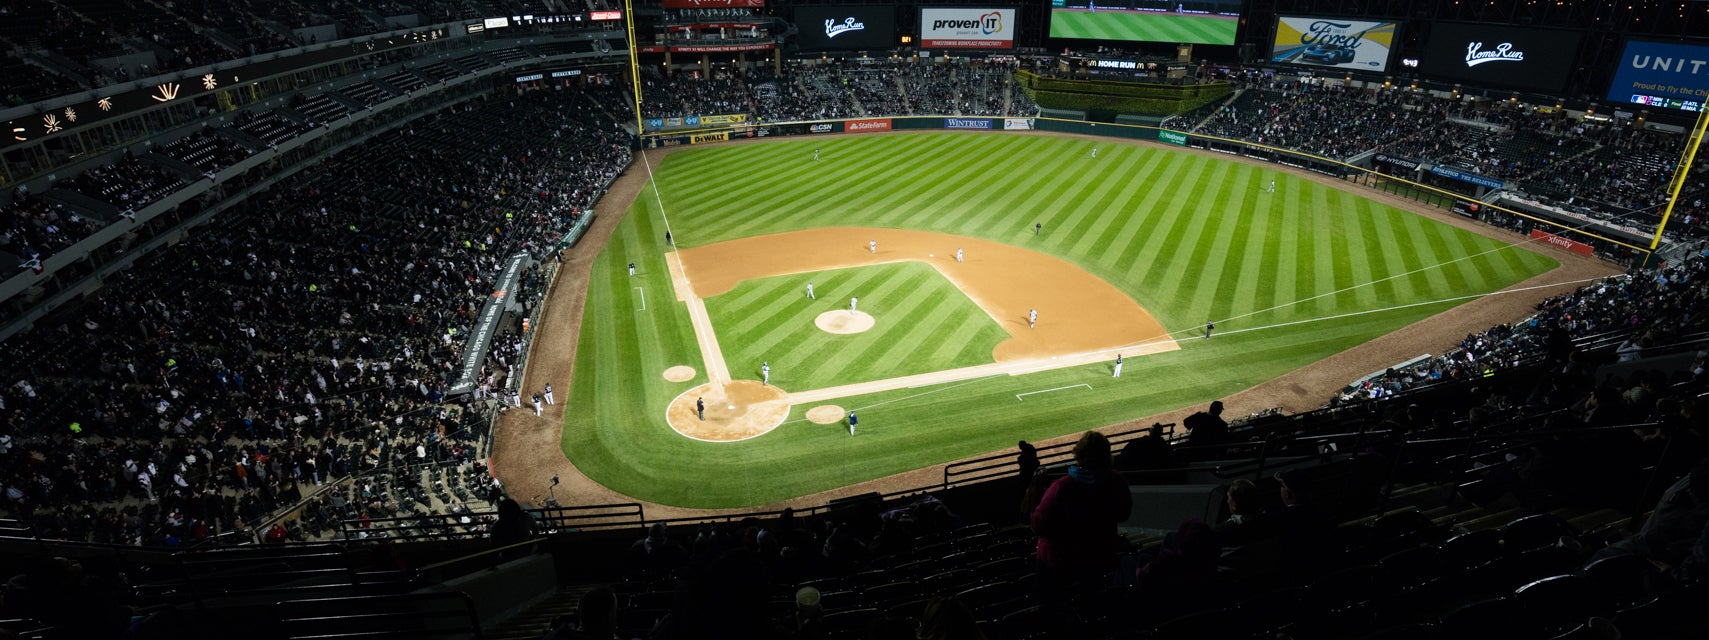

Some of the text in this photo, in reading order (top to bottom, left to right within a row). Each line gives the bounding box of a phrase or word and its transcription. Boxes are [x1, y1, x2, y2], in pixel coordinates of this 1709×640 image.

[933, 18, 997, 31] proven IT
[1301, 20, 1366, 49] Ford
[1098, 60, 1119, 68] HOME
[1119, 61, 1136, 69] RUN
[1632, 54, 1709, 75] UNIT
[1633, 81, 1656, 90] Proud
[1667, 85, 1678, 93] fly
[1165, 132, 1186, 141] National
[1387, 157, 1417, 168] HYUNDAI
[1548, 235, 1573, 249] xfinity
